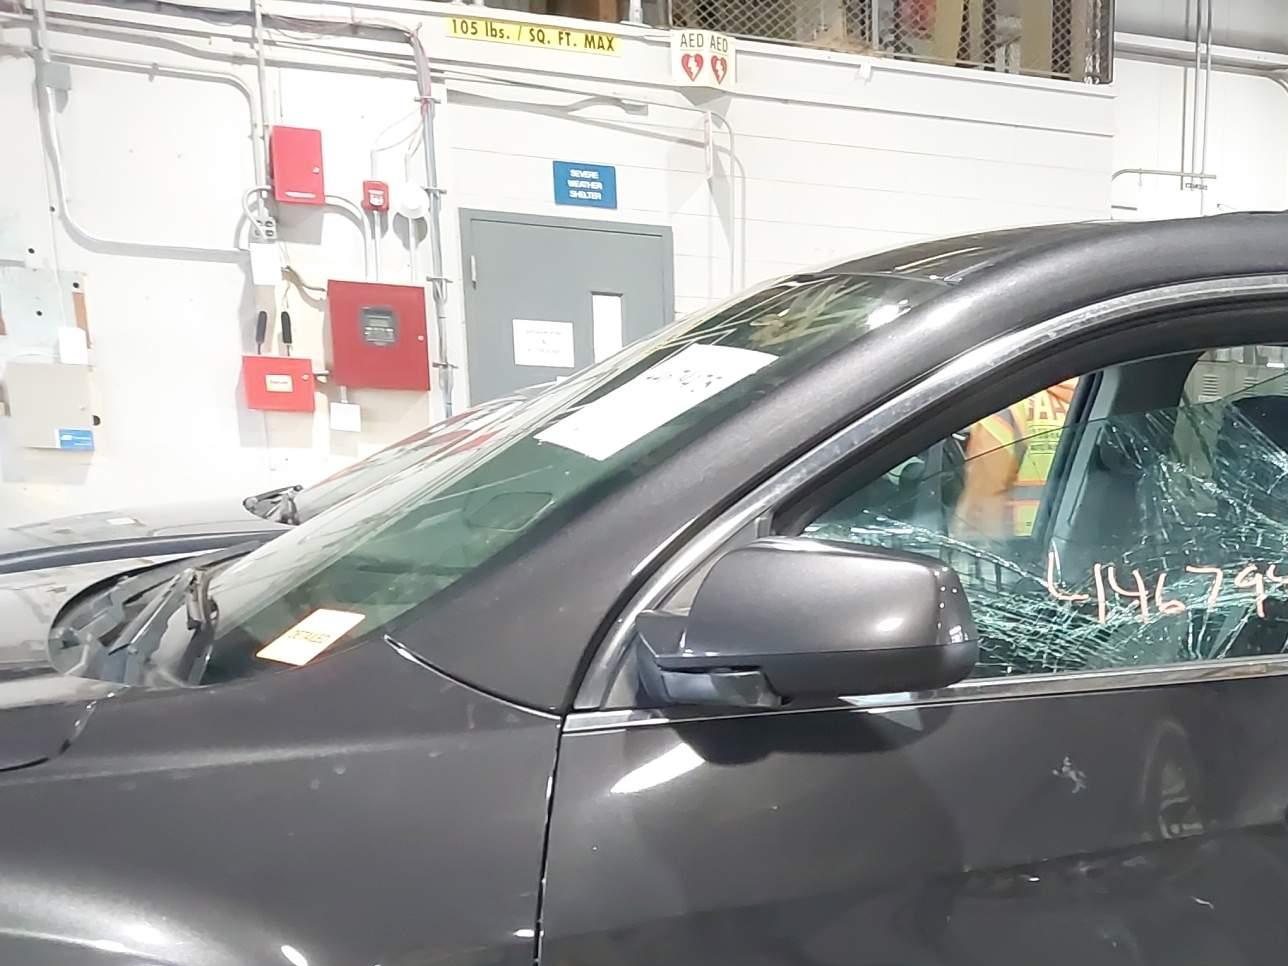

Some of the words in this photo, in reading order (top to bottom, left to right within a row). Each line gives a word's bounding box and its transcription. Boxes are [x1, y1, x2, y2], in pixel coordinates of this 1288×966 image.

[452, 19, 478, 35] 105
[485, 20, 510, 39] lbs.
[529, 27, 551, 45] SQ.
[558, 31, 577, 47] FT.
[584, 33, 615, 52] MAX
[680, 33, 704, 48] AED
[710, 34, 728, 53] AED
[568, 189, 602, 200] SHELTER
